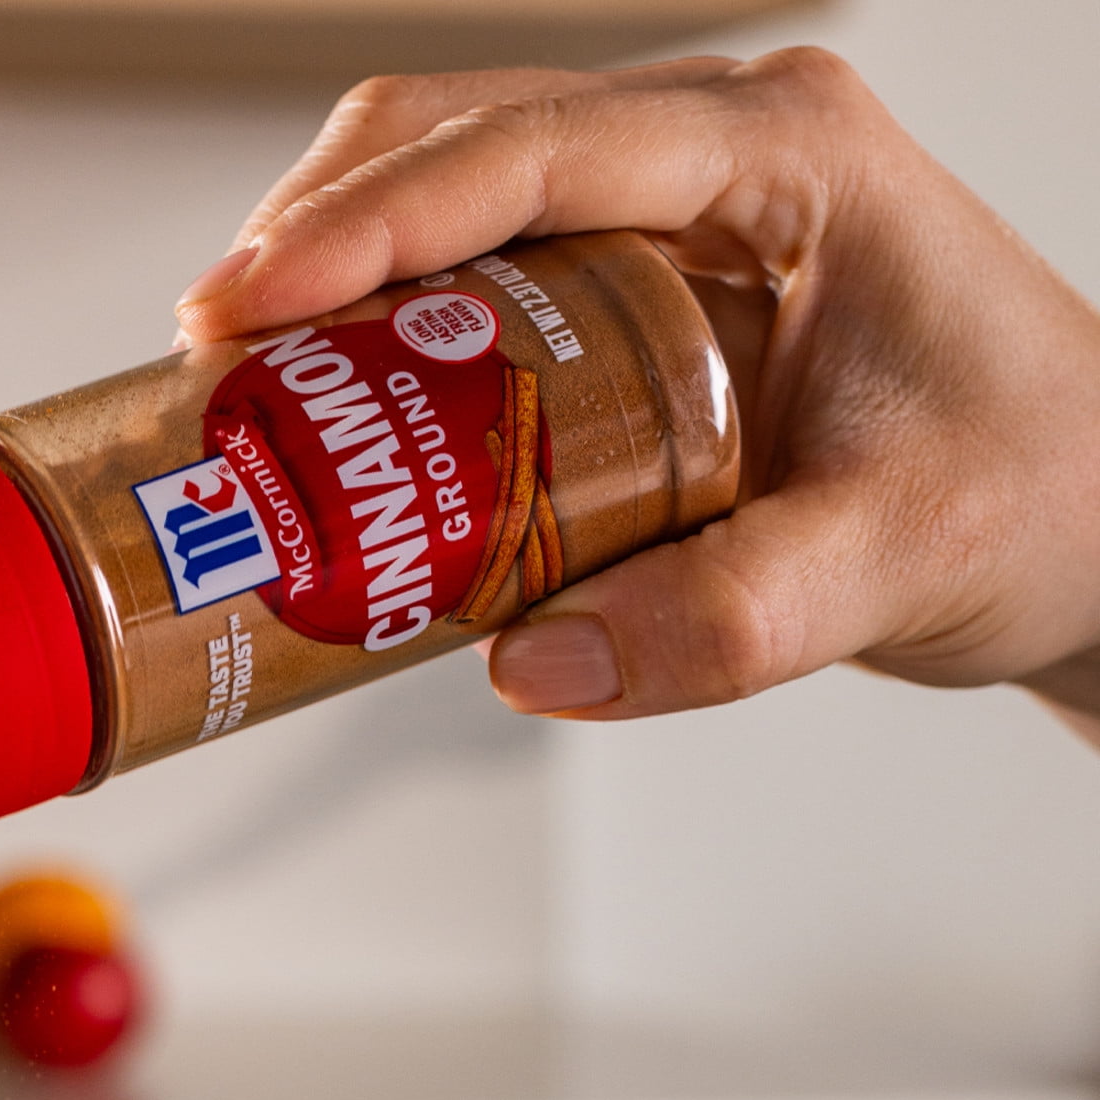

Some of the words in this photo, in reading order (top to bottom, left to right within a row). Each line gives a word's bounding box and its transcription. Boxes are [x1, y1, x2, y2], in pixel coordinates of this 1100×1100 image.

[490, 267, 526, 286] OZ
[505, 281, 550, 309] 2.37
[407, 320, 437, 343] LONG
[417, 308, 457, 345] LASTING
[435, 306, 468, 335] FRESH
[448, 299, 485, 333] FLAVOR
[528, 306, 566, 333] WT
[544, 329, 585, 363] NET
[386, 371, 471, 541] GROUND
[245, 326, 432, 652] CINNAMON
[208, 635, 230, 710] TASTE
[197, 708, 225, 741] THE
